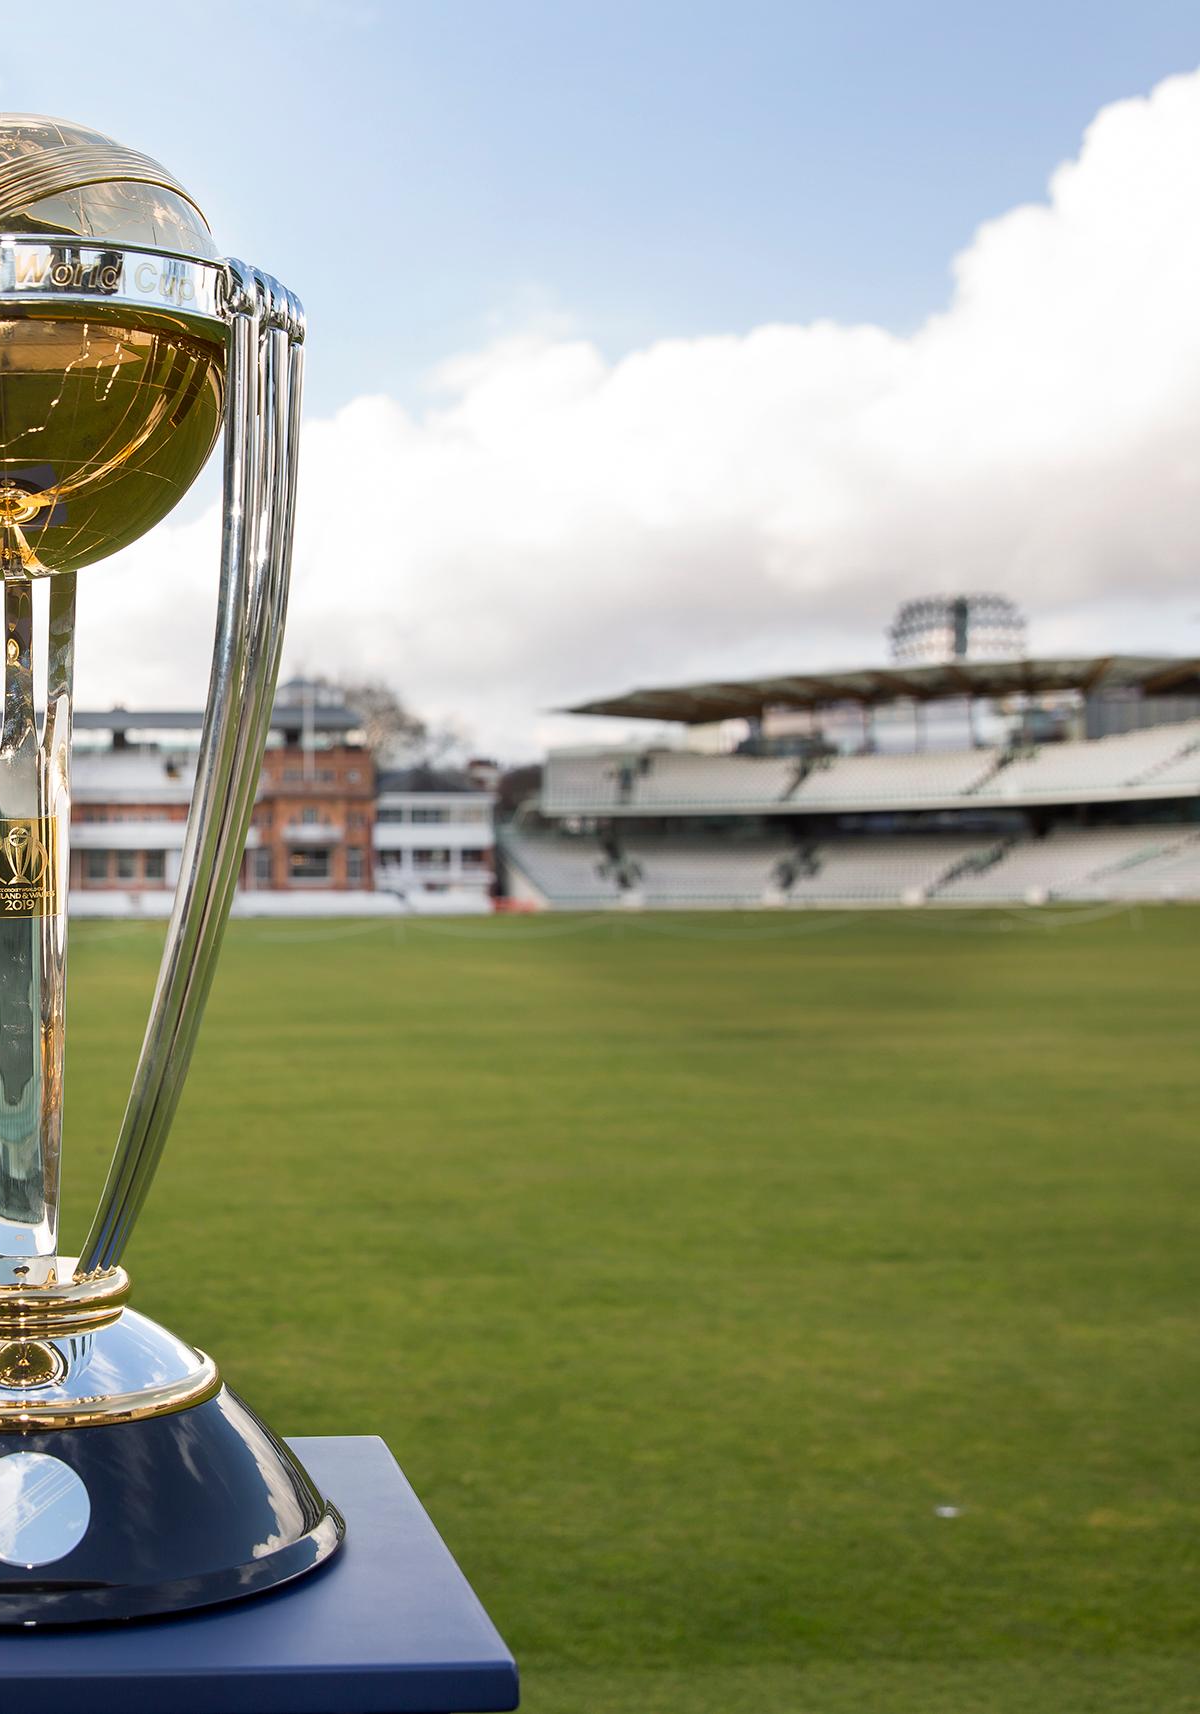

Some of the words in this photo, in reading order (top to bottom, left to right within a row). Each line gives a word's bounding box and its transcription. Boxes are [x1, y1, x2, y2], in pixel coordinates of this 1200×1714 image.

[15, 254, 124, 289] World
[134, 262, 195, 306] Cup
[4, 899, 35, 910] 2019
